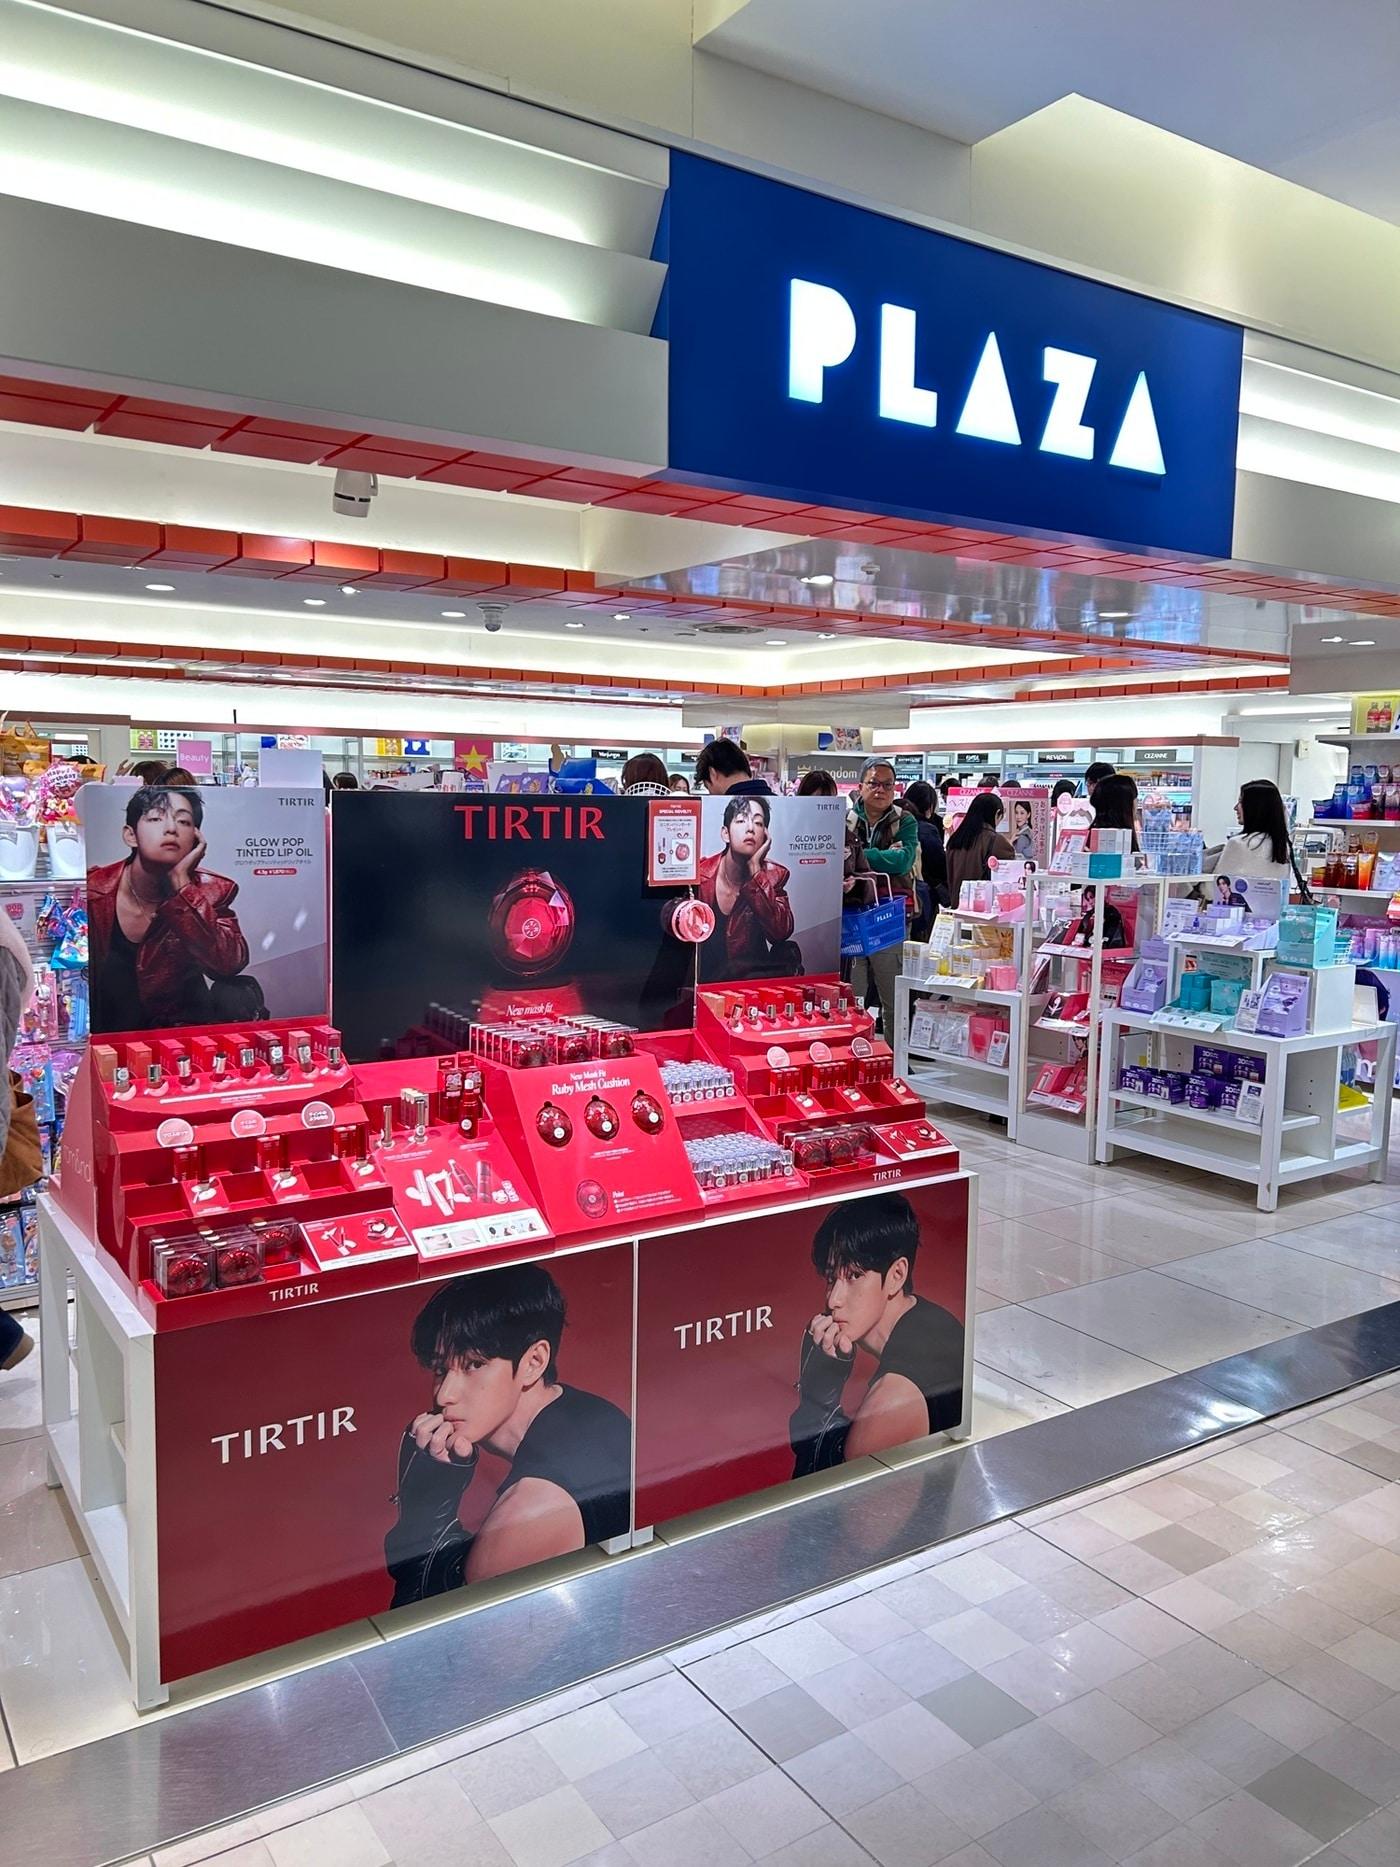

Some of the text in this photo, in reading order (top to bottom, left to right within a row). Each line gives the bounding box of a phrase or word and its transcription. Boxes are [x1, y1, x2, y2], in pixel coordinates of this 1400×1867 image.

[789, 278, 1167, 475] PLAZA
[179, 752, 209, 764] Beauty
[278, 797, 315, 807] TIRTIR
[817, 803, 840, 811] TIRTIR
[453, 804, 606, 841] TIRTIR
[244, 837, 305, 847] GLOW POP
[794, 834, 832, 843] GLOW POP
[235, 847, 314, 857] TINTED LIP OIL
[789, 843, 814, 851] TINTED
[826, 842, 837, 850] OIL
[876, 912, 893, 923] PLAZA
[506, 1003, 555, 1017] New mask fit
[569, 1072, 583, 1081] New
[583, 1071, 598, 1080] Mask
[551, 1077, 631, 1097] Ruby Mesh Cushion
[871, 1168, 902, 1183] TIRTIR
[268, 1282, 320, 1303] TIRTIR
[674, 1304, 774, 1351] TIRTIR
[211, 1405, 358, 1465] TIRTIR
